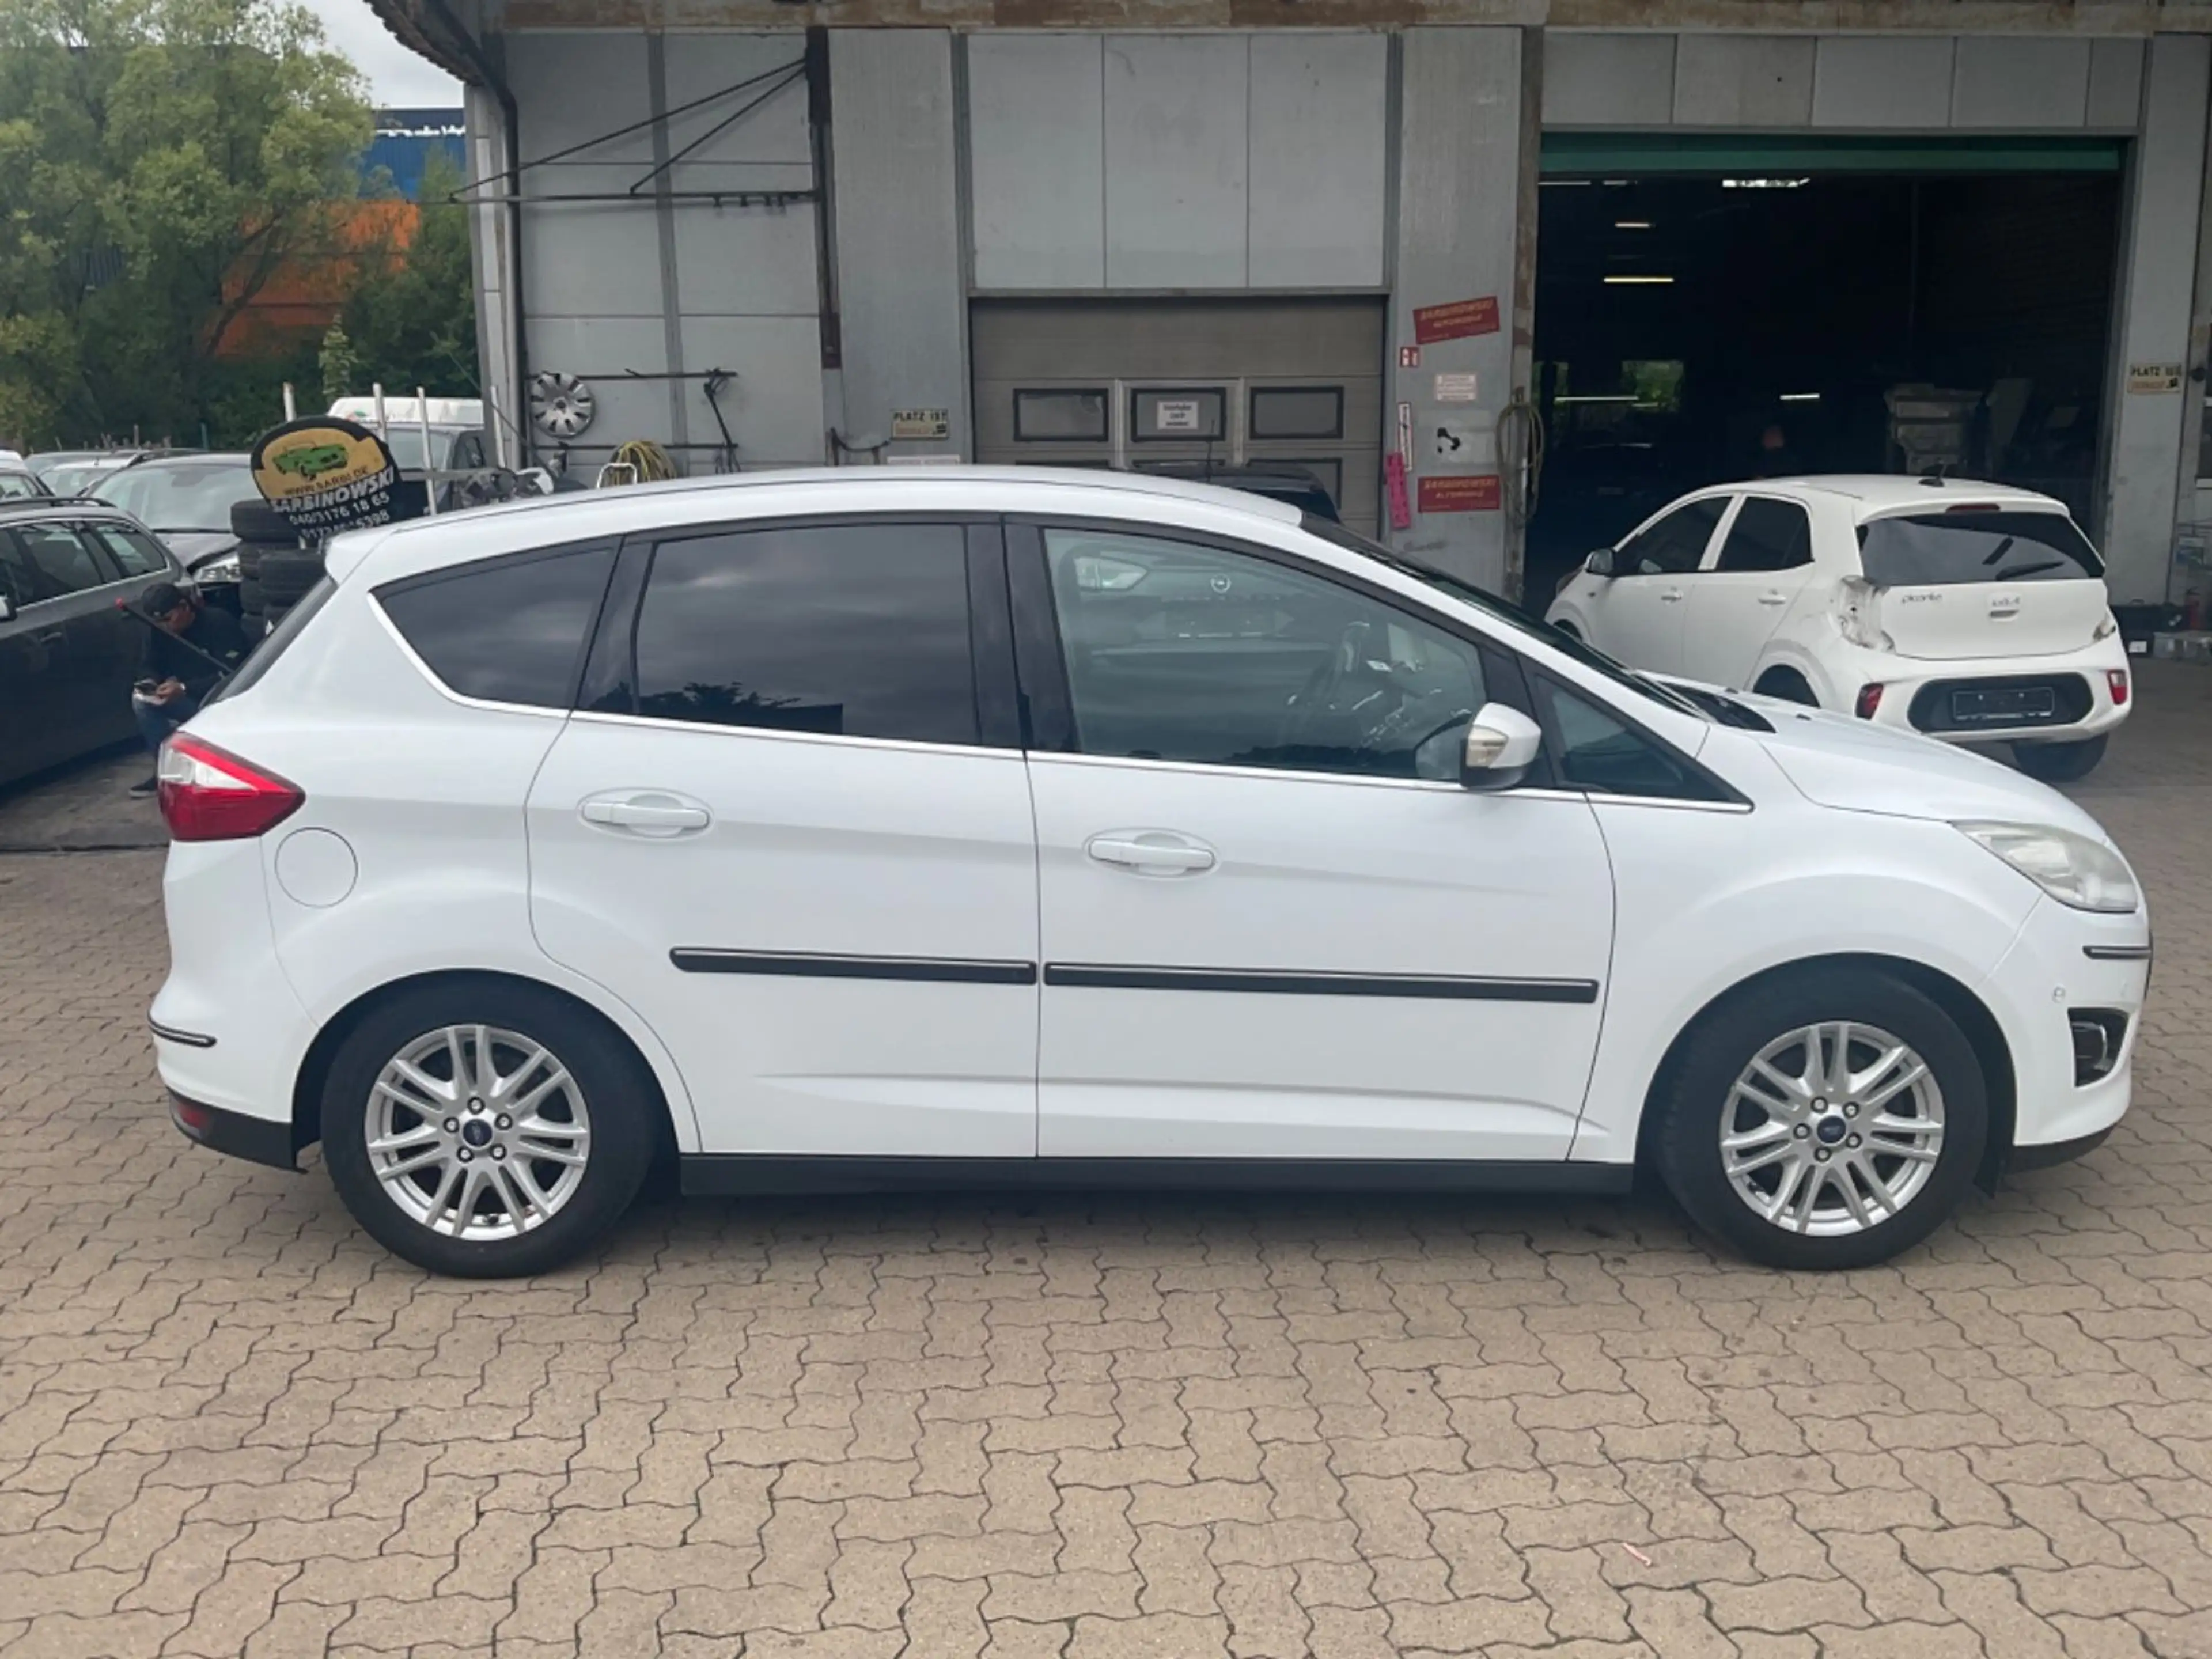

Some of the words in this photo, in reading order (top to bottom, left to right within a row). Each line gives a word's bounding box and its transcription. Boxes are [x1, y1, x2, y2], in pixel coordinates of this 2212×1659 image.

[2131, 366, 2161, 377] PLATZ
[893, 411, 926, 422] PLATZ
[270, 465, 394, 513] SARBINOWSKI
[371, 491, 390, 506] 65
